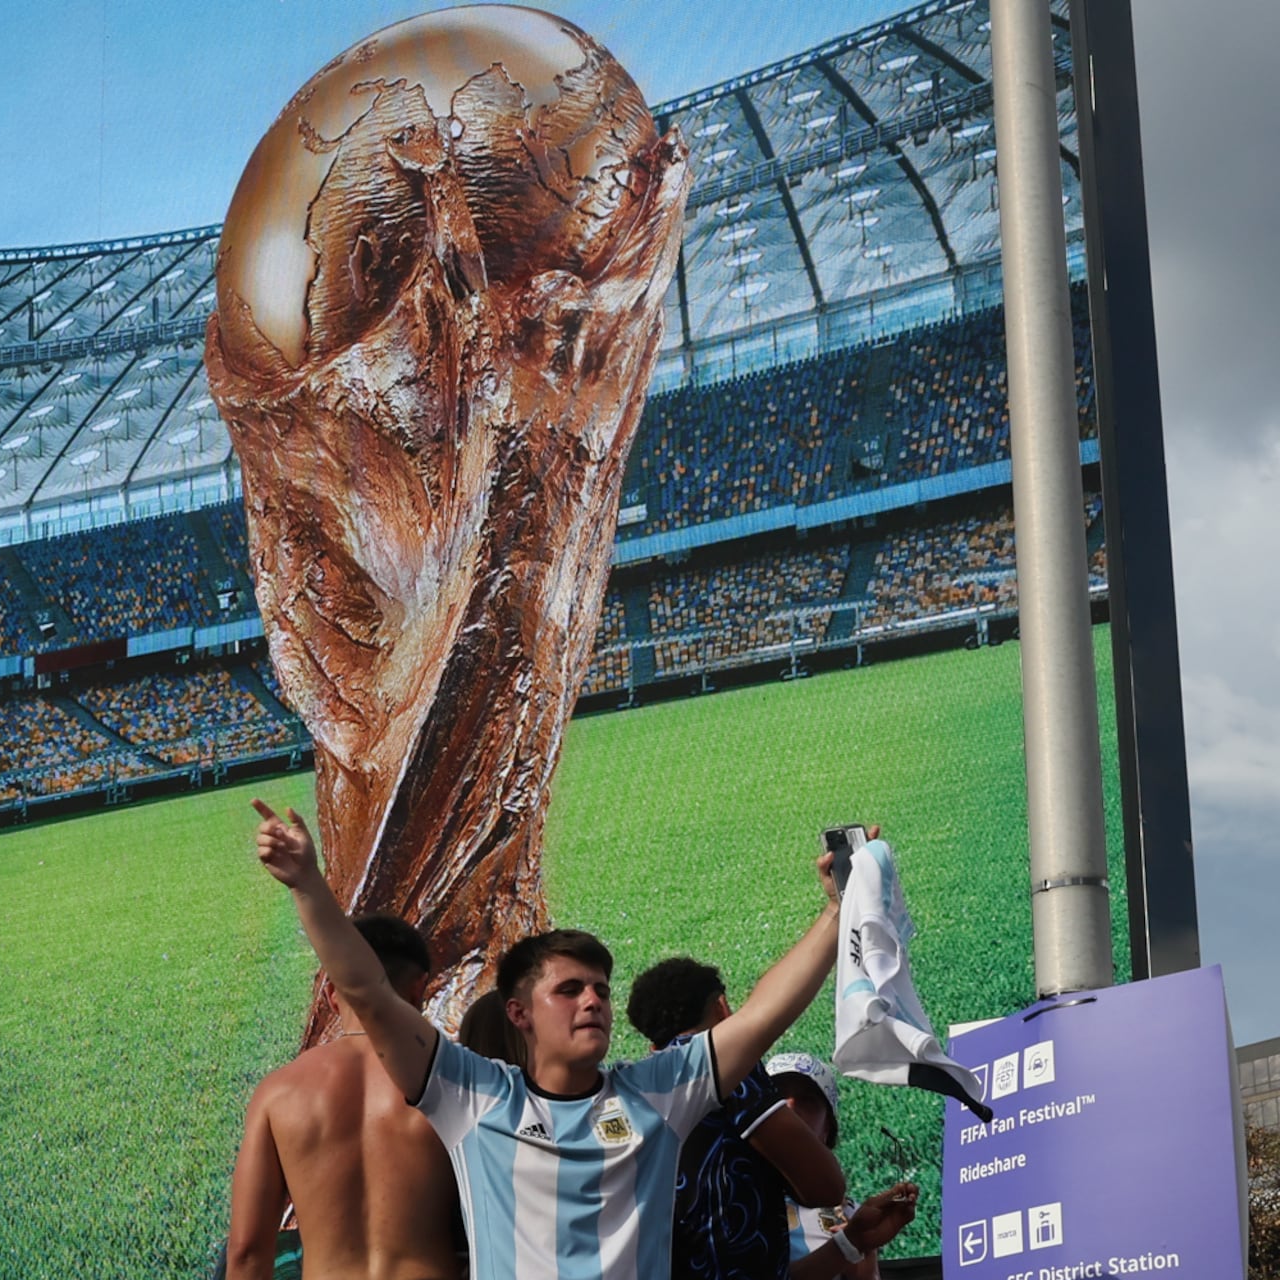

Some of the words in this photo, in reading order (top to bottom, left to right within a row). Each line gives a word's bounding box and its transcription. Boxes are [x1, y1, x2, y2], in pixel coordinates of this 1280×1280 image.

[960, 1123, 988, 1146] FIFA
[991, 1116, 1015, 1136] Fan
[959, 1153, 1026, 1184] Rideshare
[1108, 1252, 1180, 1276] Station
